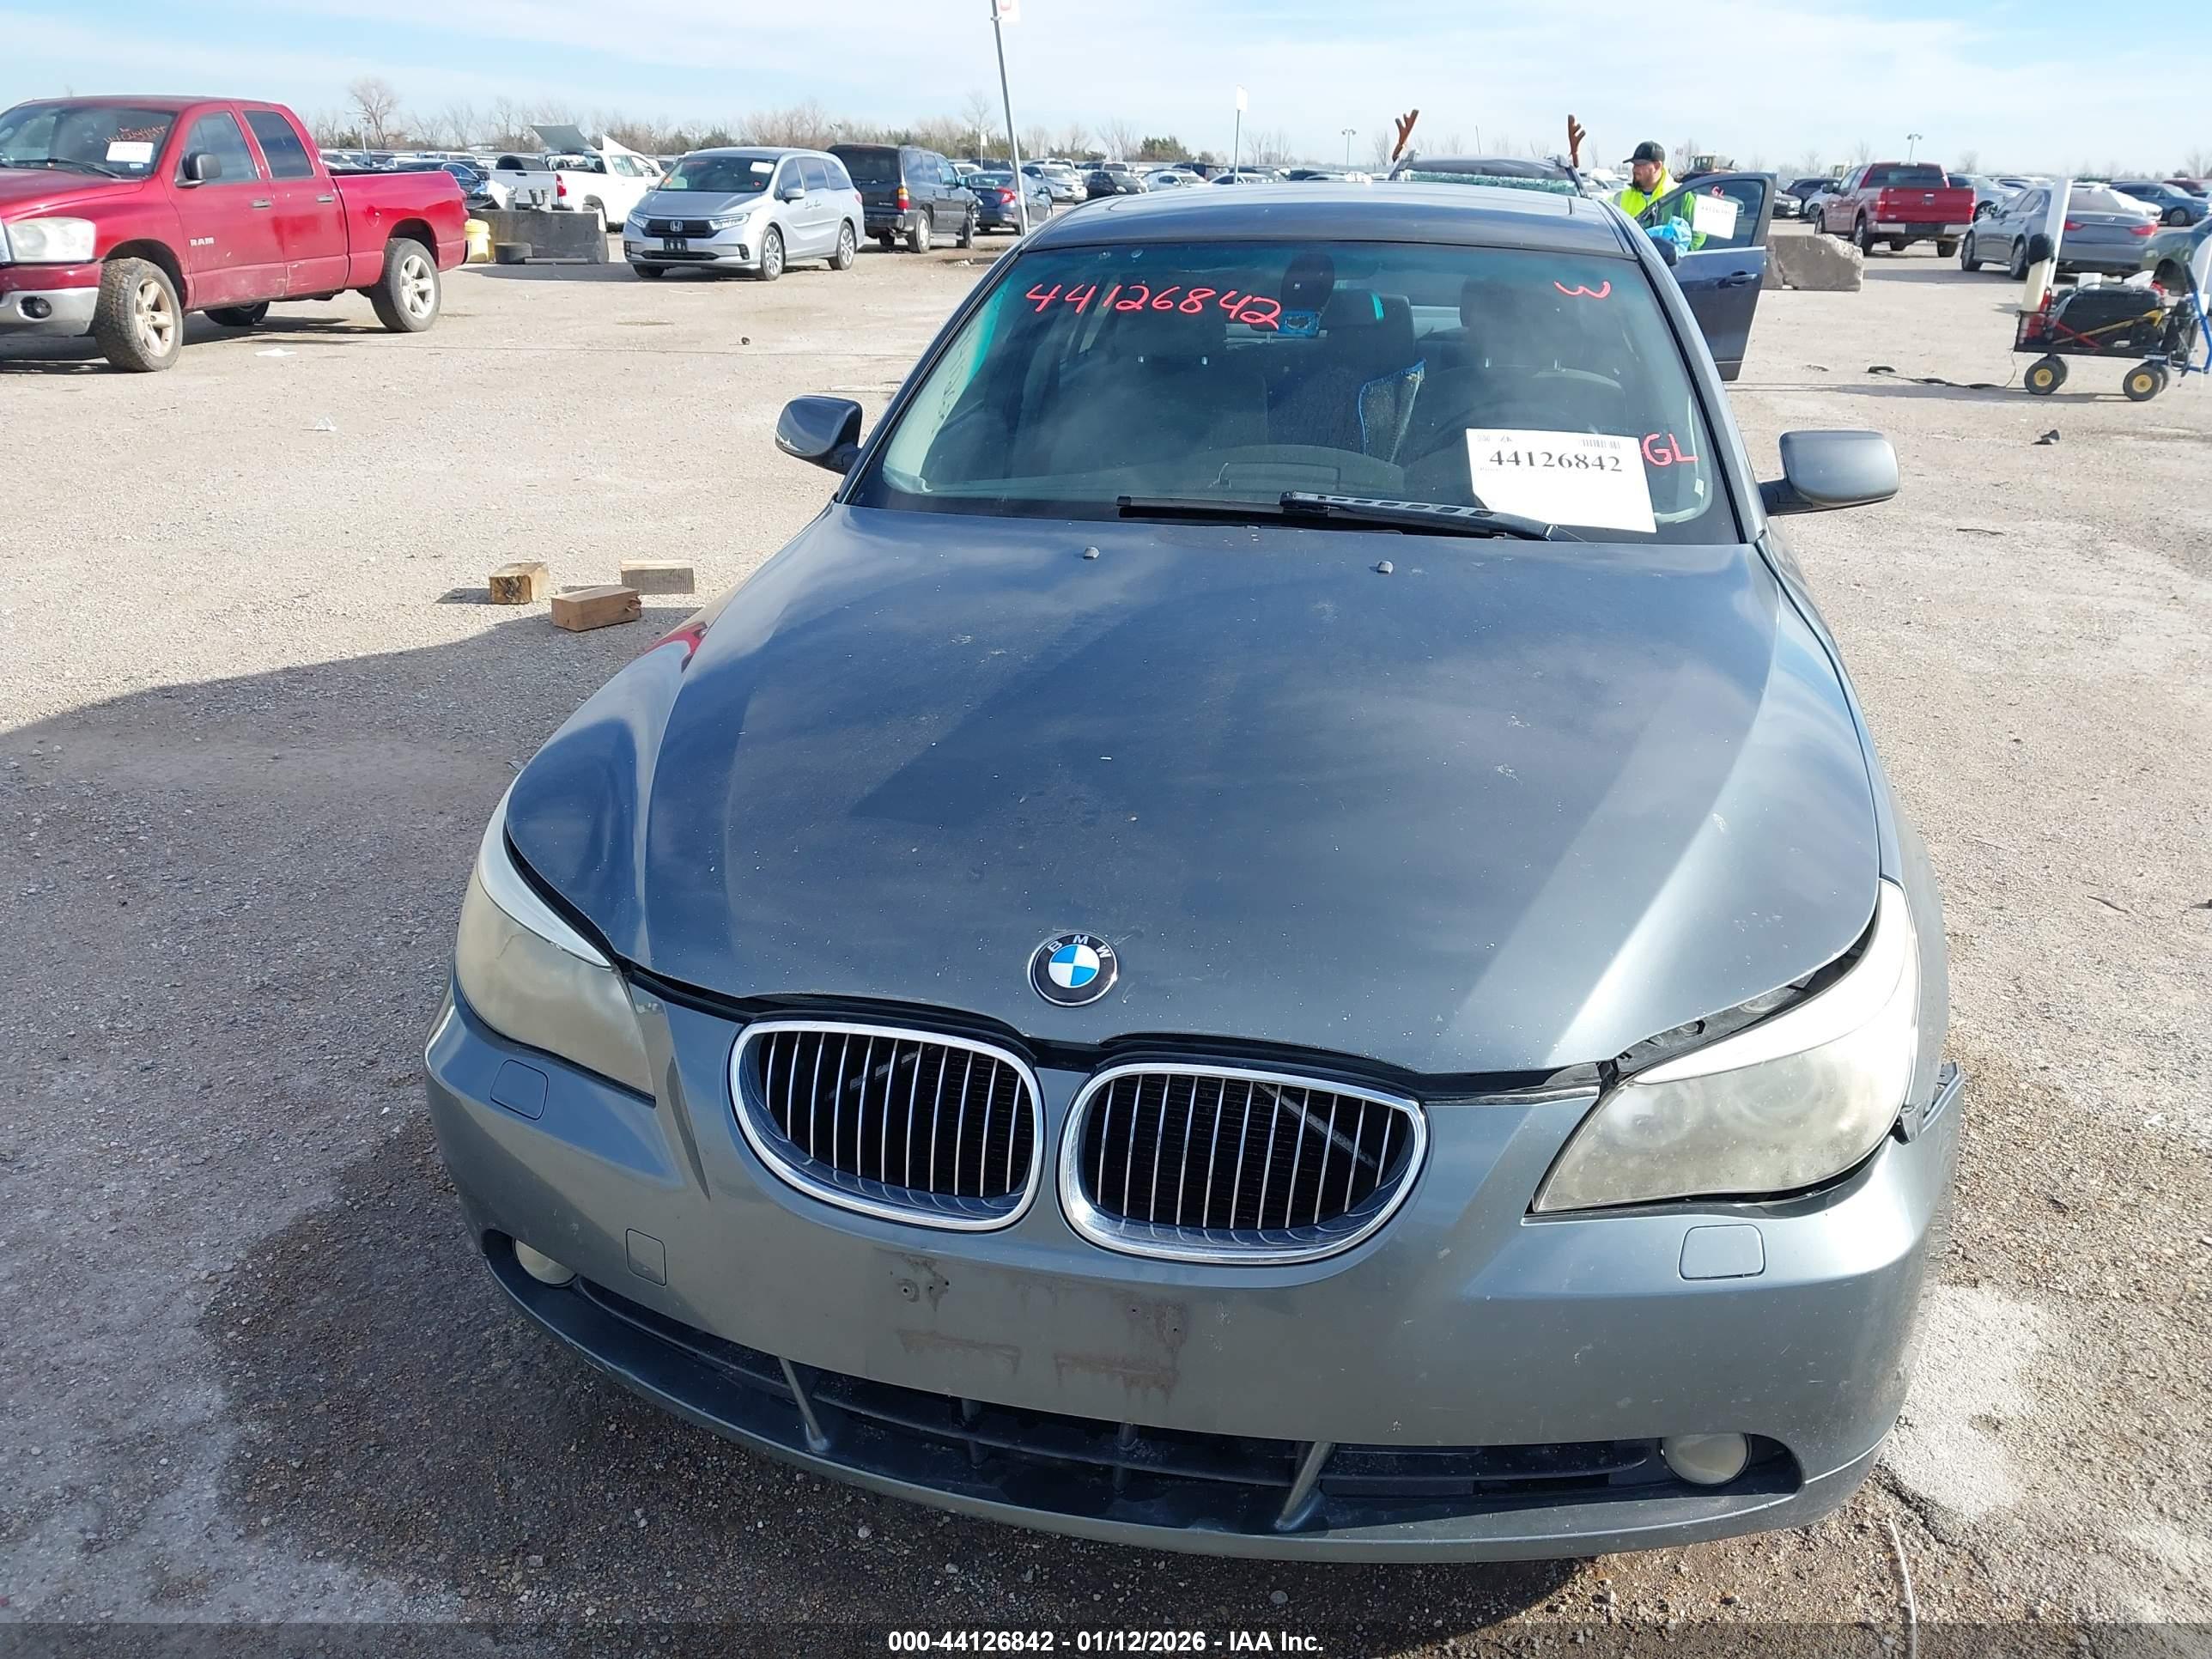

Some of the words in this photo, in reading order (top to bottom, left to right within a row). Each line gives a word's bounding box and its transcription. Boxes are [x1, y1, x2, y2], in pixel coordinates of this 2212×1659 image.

[189, 236, 215, 247] RAM
[1024, 282, 1282, 331] 44126842
[1489, 449, 1623, 472] 44126842
[1641, 432, 1699, 467] GL
[1047, 934, 1113, 959] BMW
